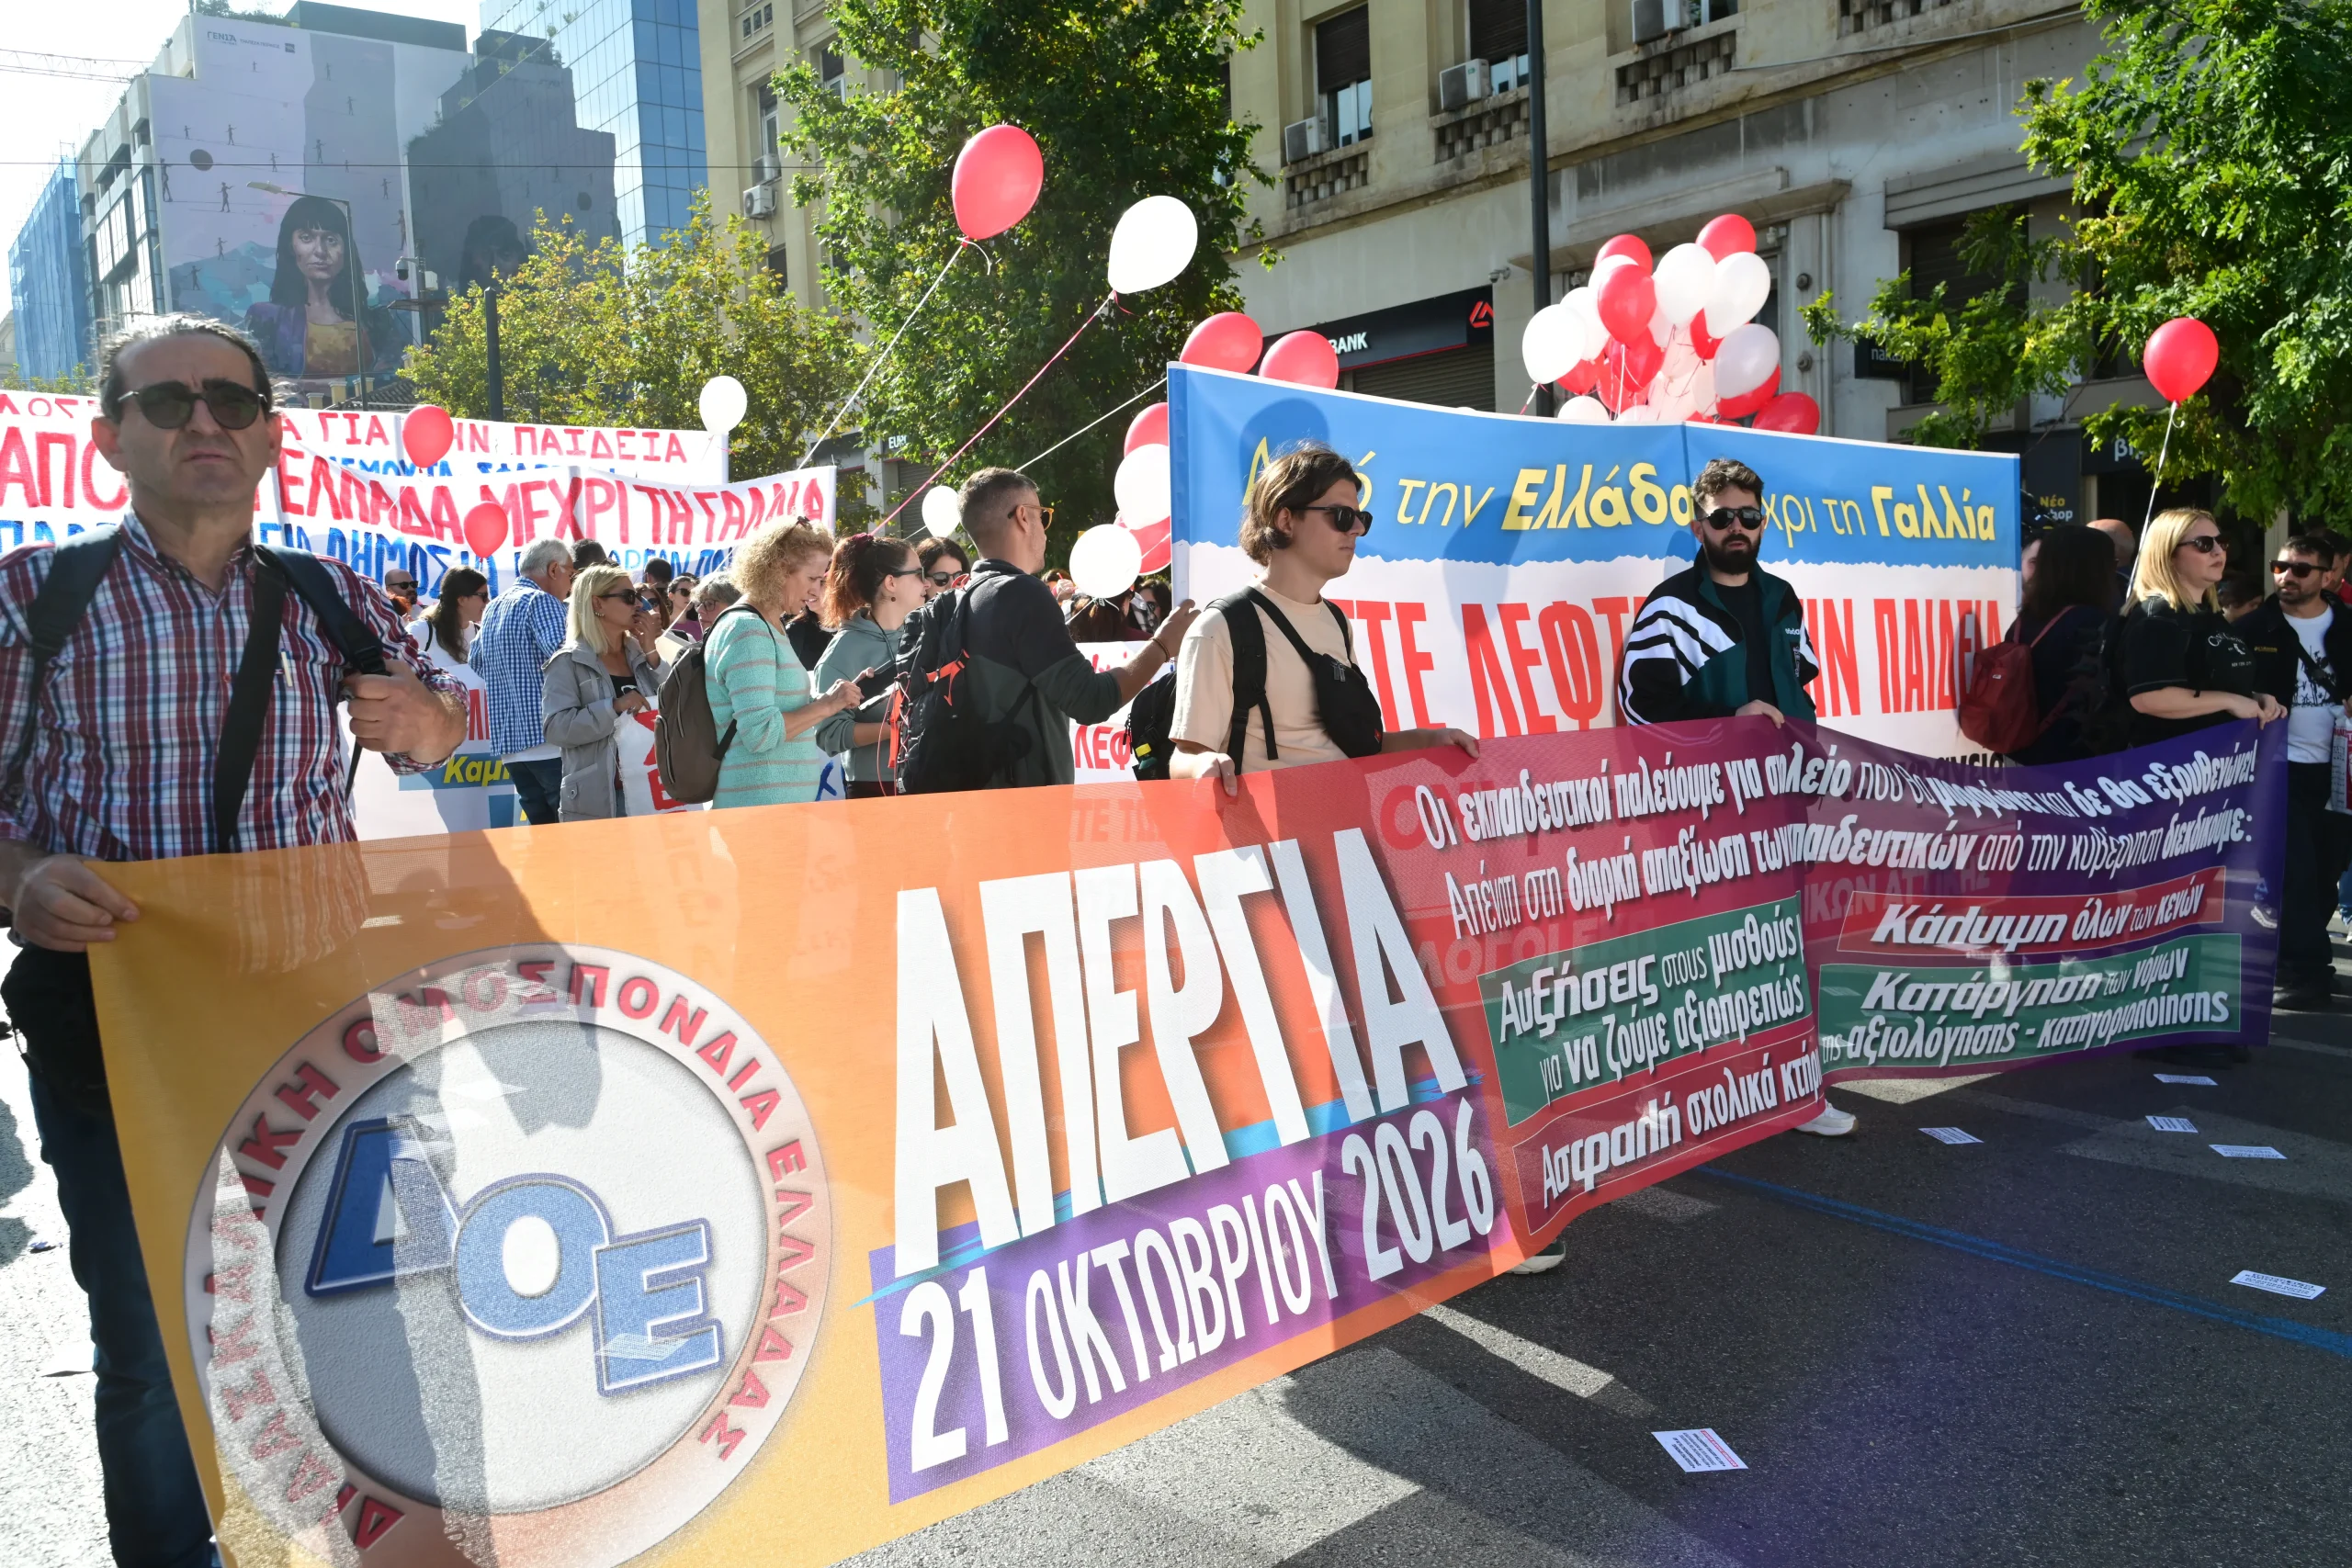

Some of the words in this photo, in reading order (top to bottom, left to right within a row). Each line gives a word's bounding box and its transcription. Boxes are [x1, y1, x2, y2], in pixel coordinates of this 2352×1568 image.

[1329, 332, 1368, 355] BANK
[0, 426, 130, 512] ΑΠΟ
[318, 412, 390, 446] ΓΙΑ
[453, 422, 490, 454] ΗΝ
[514, 426, 687, 463] ΠΑΙΔΕΙΑ
[277, 447, 464, 545] ΕΛΛΑΔΑ
[480, 477, 629, 547] ΜΕΧΡΙ
[632, 484, 695, 545] ΤΗ
[693, 478, 825, 544] ΓΑΛΛΙΑ
[1397, 479, 1496, 529] την
[1500, 461, 1694, 531] Ελλάδα
[1764, 492, 1816, 548] χρι
[1822, 497, 1867, 536] τη
[1871, 484, 1996, 542] Γαλλία
[2040, 494, 2065, 507] Νέο
[327, 527, 498, 602] ΔΗΜΟΣΑ
[1461, 596, 1651, 739] ΛΕΦΤ
[1074, 724, 1133, 771] ΛΕΦ
[1415, 784, 1458, 850] Οι
[1457, 759, 1612, 842] εκπαιδευτικοί
[1613, 751, 1725, 821] παλεύουμε
[1724, 758, 1764, 816] για
[1856, 761, 1904, 803] που
[1894, 762, 1937, 805] θα
[1925, 779, 2043, 819] μορφώνει
[2034, 792, 2081, 818] και
[2064, 781, 2112, 818] δε
[2097, 776, 2154, 809] θα
[2142, 739, 2258, 807] εξουθενώνει!
[1524, 866, 1565, 921] στη
[1566, 835, 1641, 922] διαρκή
[1643, 824, 1751, 898] απαξίωση
[1750, 827, 1790, 874] των
[1977, 819, 2024, 872] από
[2027, 834, 2066, 872] την
[2066, 826, 2164, 880] κυβέρνηση
[2161, 798, 2253, 860] διεκδικούμε:
[1870, 903, 2068, 953] Κάλυψη
[2071, 897, 2133, 942] όλων
[2130, 904, 2157, 932] των
[2154, 875, 2205, 927] κενών
[1499, 953, 1658, 1043] Αυξήσεις
[1661, 946, 1708, 989] στους
[1707, 904, 1797, 989] μισθούς
[1860, 970, 2103, 1020] Κατάργηση
[2103, 968, 2133, 997] των
[2132, 945, 2189, 995] νόμων
[894, 827, 1469, 1278] ΑΠΕΡΓΙΑ
[1539, 1054, 1563, 1107] για
[1563, 1032, 1600, 1085] να
[1601, 1003, 1670, 1082] ζούμε
[1673, 963, 1804, 1054] αξιοπρεπώς
[1847, 1014, 2020, 1068] αξιολόγησης
[2036, 983, 2230, 1051] κατηγοριοποίησης
[1542, 1090, 1682, 1210] Ασφαλή
[1686, 1052, 1778, 1136] σχολικά
[304, 1113, 725, 1398] ΔΟΕ
[343, 961, 782, 1132] ΟΜΟΣΠΟΝΔΙΑ
[699, 1139, 818, 1462] ΕΛΛΑΔΑΣ
[899, 1267, 1010, 1473] 21
[1024, 1168, 1340, 1420] ΟΚΤΩΒΡΙΟΥ
[1341, 1096, 1497, 1283] 2026
